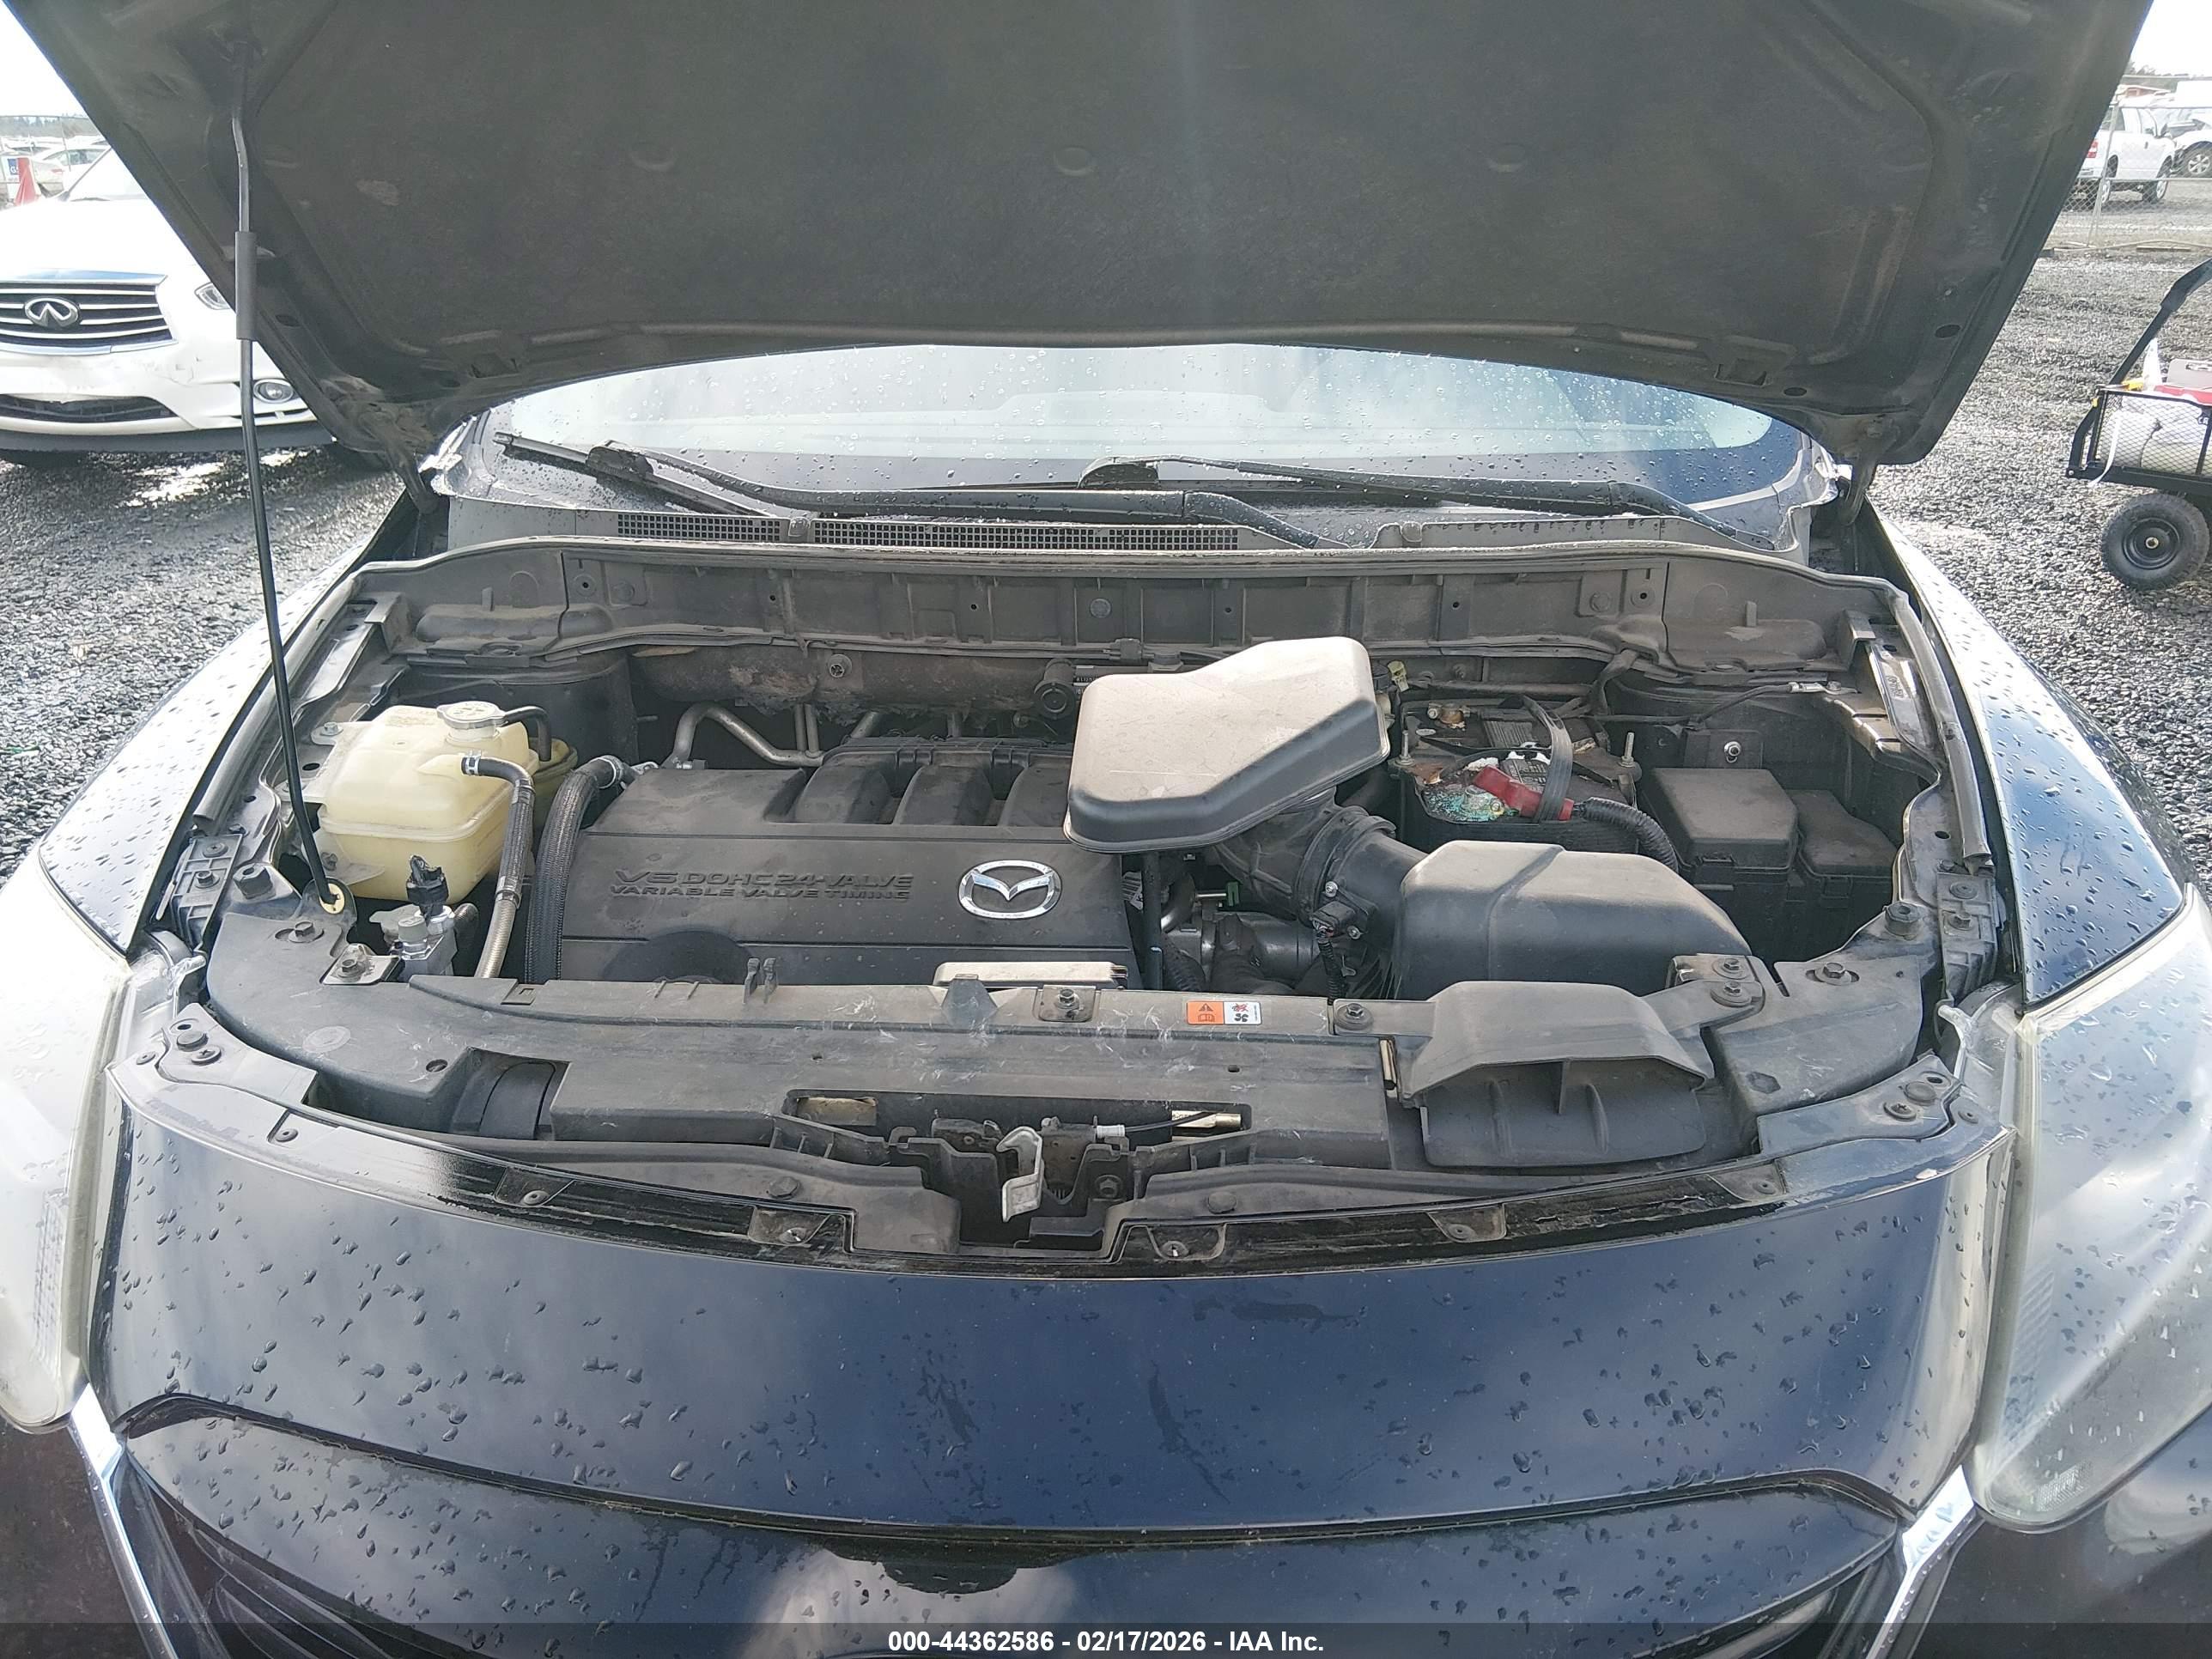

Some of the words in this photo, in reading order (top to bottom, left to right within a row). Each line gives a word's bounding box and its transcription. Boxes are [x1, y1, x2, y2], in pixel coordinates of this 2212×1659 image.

[615, 870, 678, 884] V6
[683, 872, 774, 885] DOHC
[611, 885, 736, 896] VARIABLE
[741, 888, 818, 898] VALVE
[824, 890, 910, 900] TIMING
